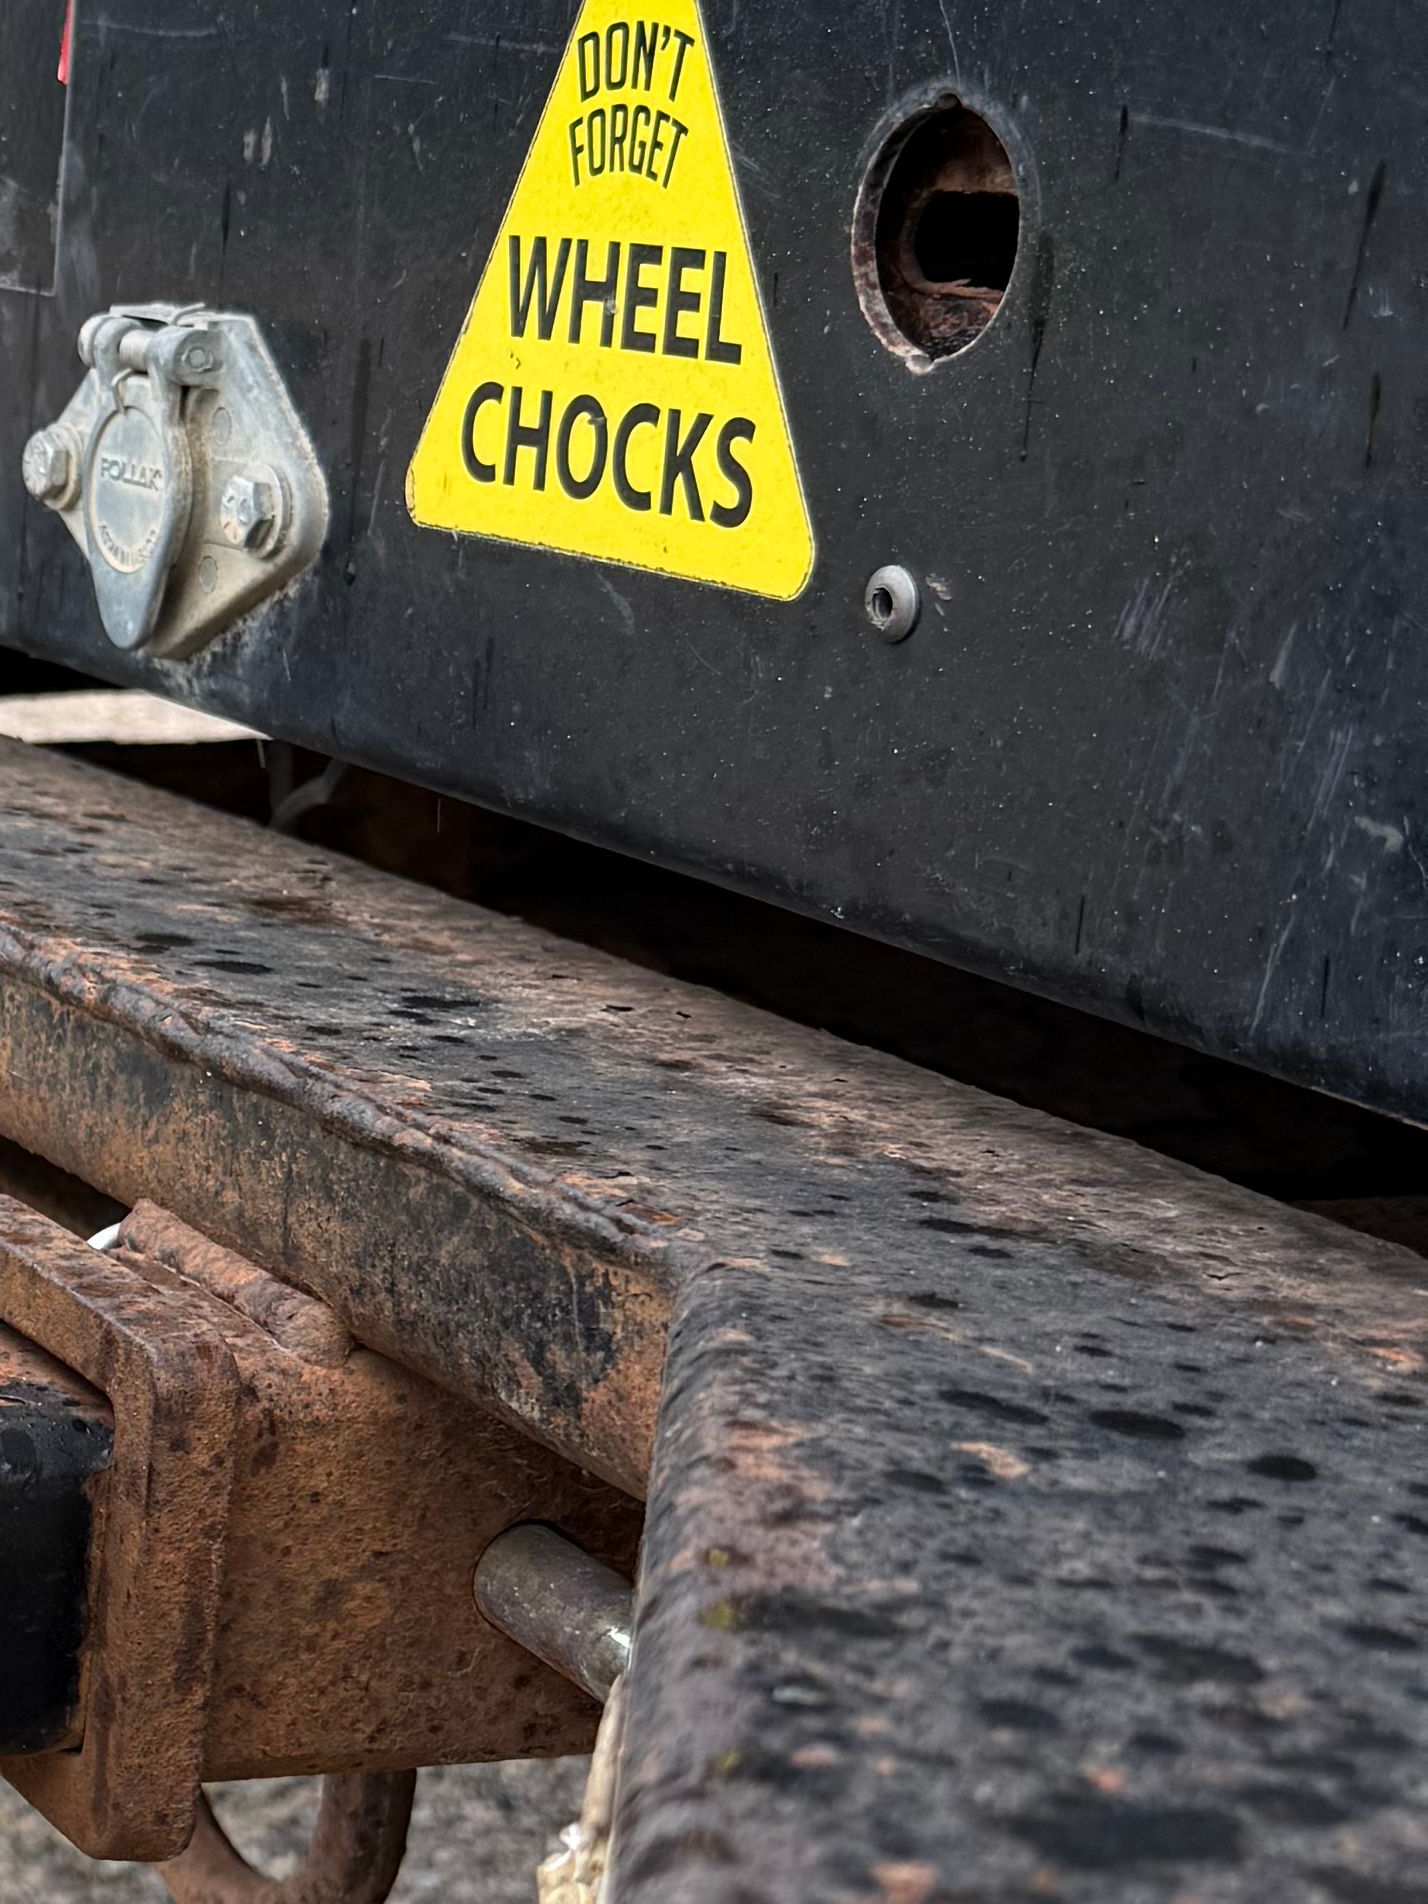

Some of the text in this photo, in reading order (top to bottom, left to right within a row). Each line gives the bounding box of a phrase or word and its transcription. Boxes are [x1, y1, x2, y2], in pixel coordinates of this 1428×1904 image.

[576, 20, 694, 103] DON'T
[568, 105, 688, 189] FORGET
[507, 234, 743, 366] WHEEL
[101, 457, 162, 491] POLLAK
[461, 382, 755, 529] CHOCKS
